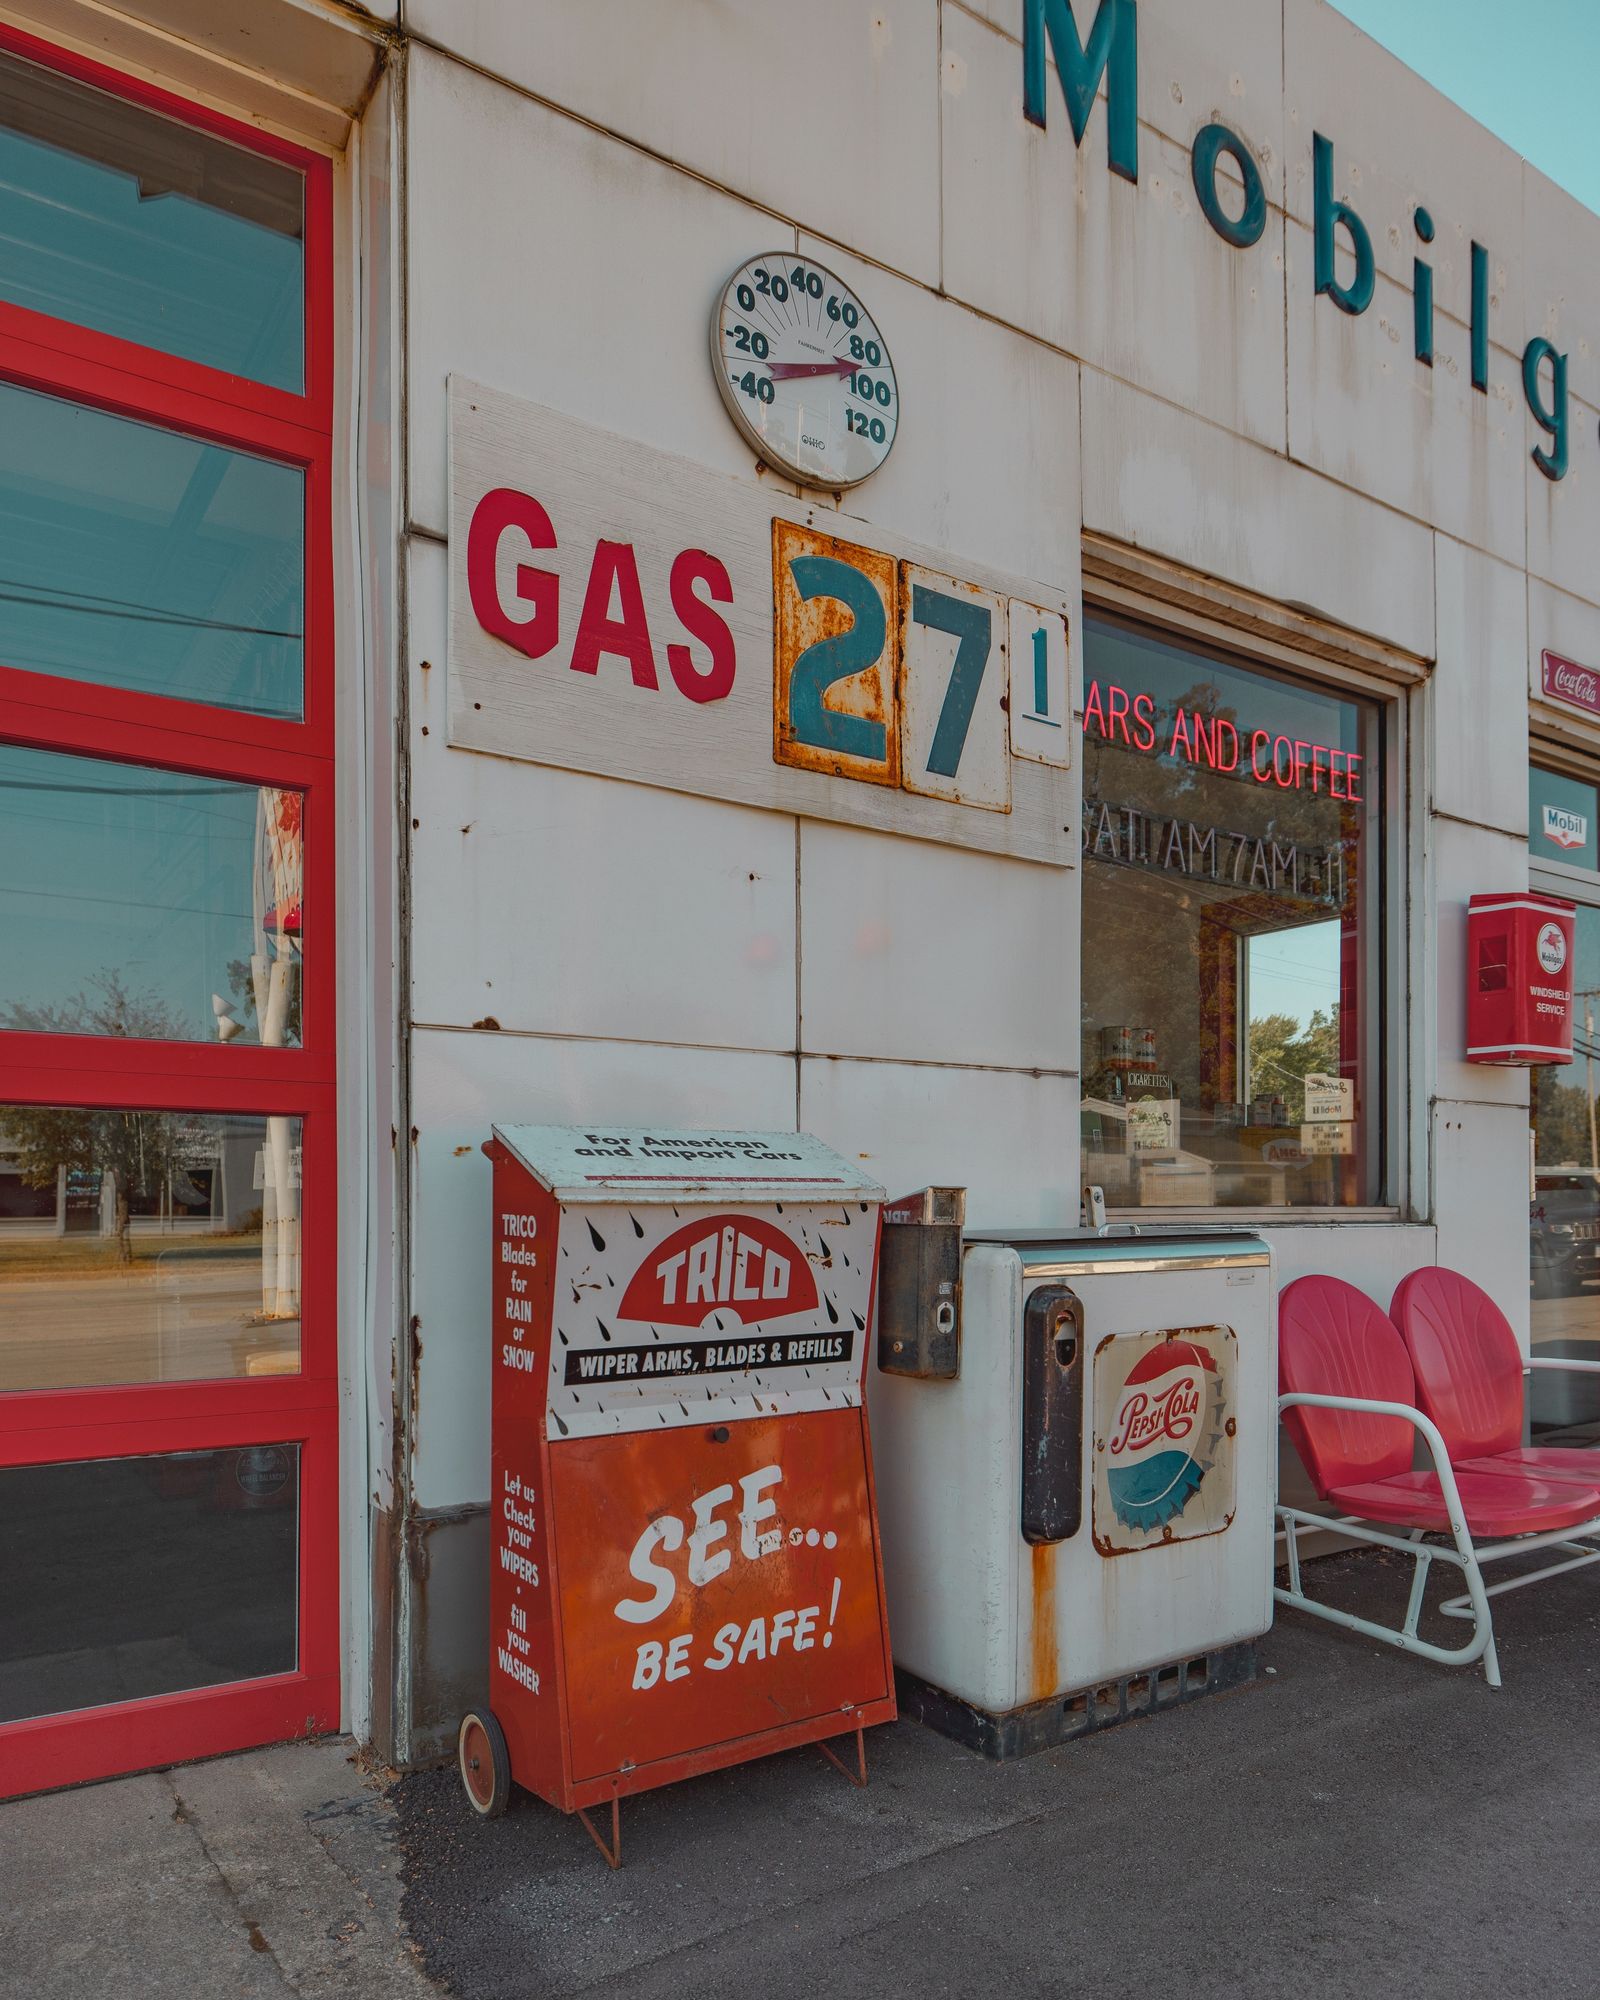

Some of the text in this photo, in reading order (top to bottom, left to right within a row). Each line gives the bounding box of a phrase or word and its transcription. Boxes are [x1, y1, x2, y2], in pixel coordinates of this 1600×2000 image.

[1023, 0, 1600, 481] Mobilg
[737, 284, 756, 312] 0
[754, 268, 789, 303] 20
[790, 266, 824, 300] 40
[826, 295, 859, 329] 60
[725, 325, 770, 360] -20
[849, 335, 881, 367] 80
[731, 370, 776, 405] -40
[849, 371, 891, 407] 100
[846, 408, 886, 444] 120
[467, 487, 737, 703] GAS
[1170, 708, 1239, 771] AND
[1252, 730, 1363, 802] COFFEE
[1548, 809, 1582, 834] Mobil
[1541, 951, 1563, 966] Mobilgas
[1529, 985, 1571, 1001] WINDSHIELD
[1536, 1002, 1566, 1016] SERVICE
[1129, 1072, 1168, 1088] CIGARETTES
[574, 1145, 802, 1161] and Import Cars
[584, 1134, 769, 1149] For American
[502, 1214, 537, 1239] TRICO
[501, 1241, 537, 1267] Blades
[656, 1224, 791, 1305] TRICO
[511, 1270, 528, 1293] for
[505, 1297, 532, 1323] RAIN
[513, 1326, 525, 1342] or
[502, 1344, 535, 1373] SNOW
[579, 1337, 843, 1378] WIPER ARMS, BLADES & REFILLS
[504, 1470, 535, 1503] Let us
[503, 1497, 536, 1532] Check
[507, 1525, 532, 1550] your
[500, 1545, 540, 1588] WIPERS
[511, 1603, 527, 1634] fill
[632, 1577, 842, 1690] BE SAFE!
[506, 1628, 531, 1656] your
[498, 1646, 540, 1696] WASHER
